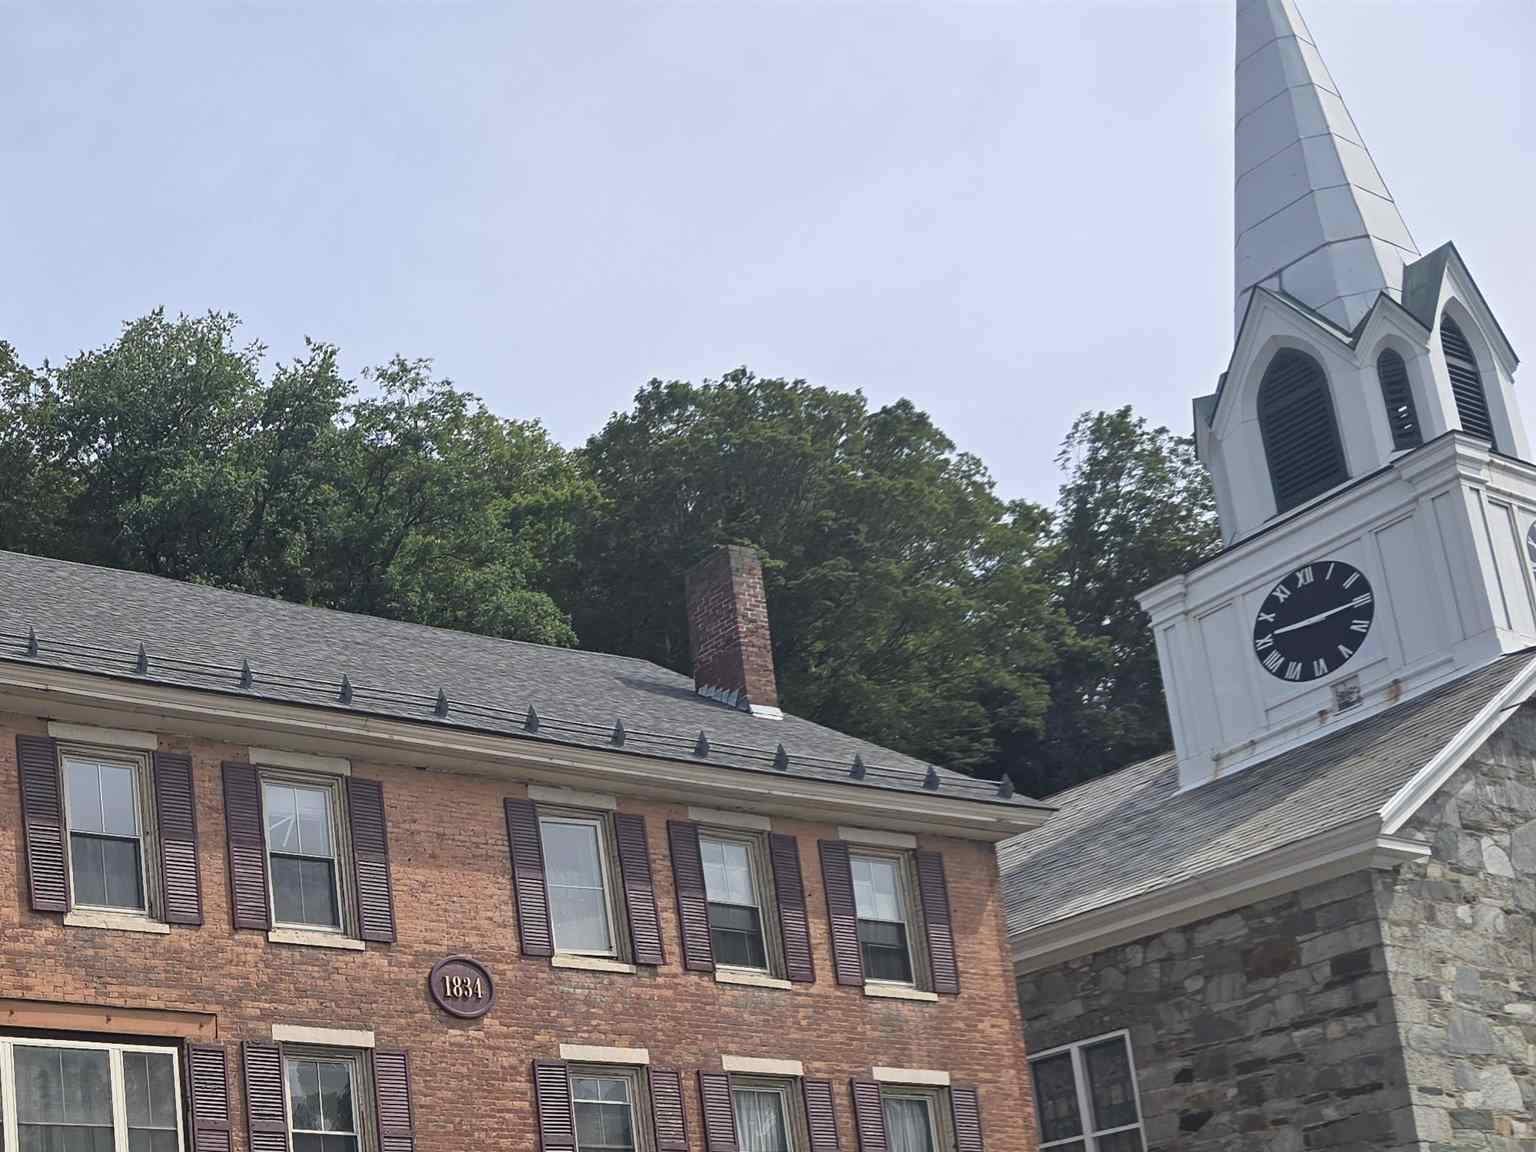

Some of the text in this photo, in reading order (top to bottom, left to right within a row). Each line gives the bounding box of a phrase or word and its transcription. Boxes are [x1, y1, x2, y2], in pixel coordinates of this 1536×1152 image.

[1295, 566, 1314, 588] XII
[1342, 572, 1360, 589] II
[1272, 585, 1291, 603] XI
[1258, 612, 1276, 622] X
[1350, 620, 1370, 632] IV
[1256, 633, 1273, 651] IX
[1337, 645, 1353, 658] V
[1263, 649, 1285, 673] VIII
[1313, 658, 1328, 676] VI
[1284, 661, 1302, 680] VII
[443, 975, 482, 999] 1834
